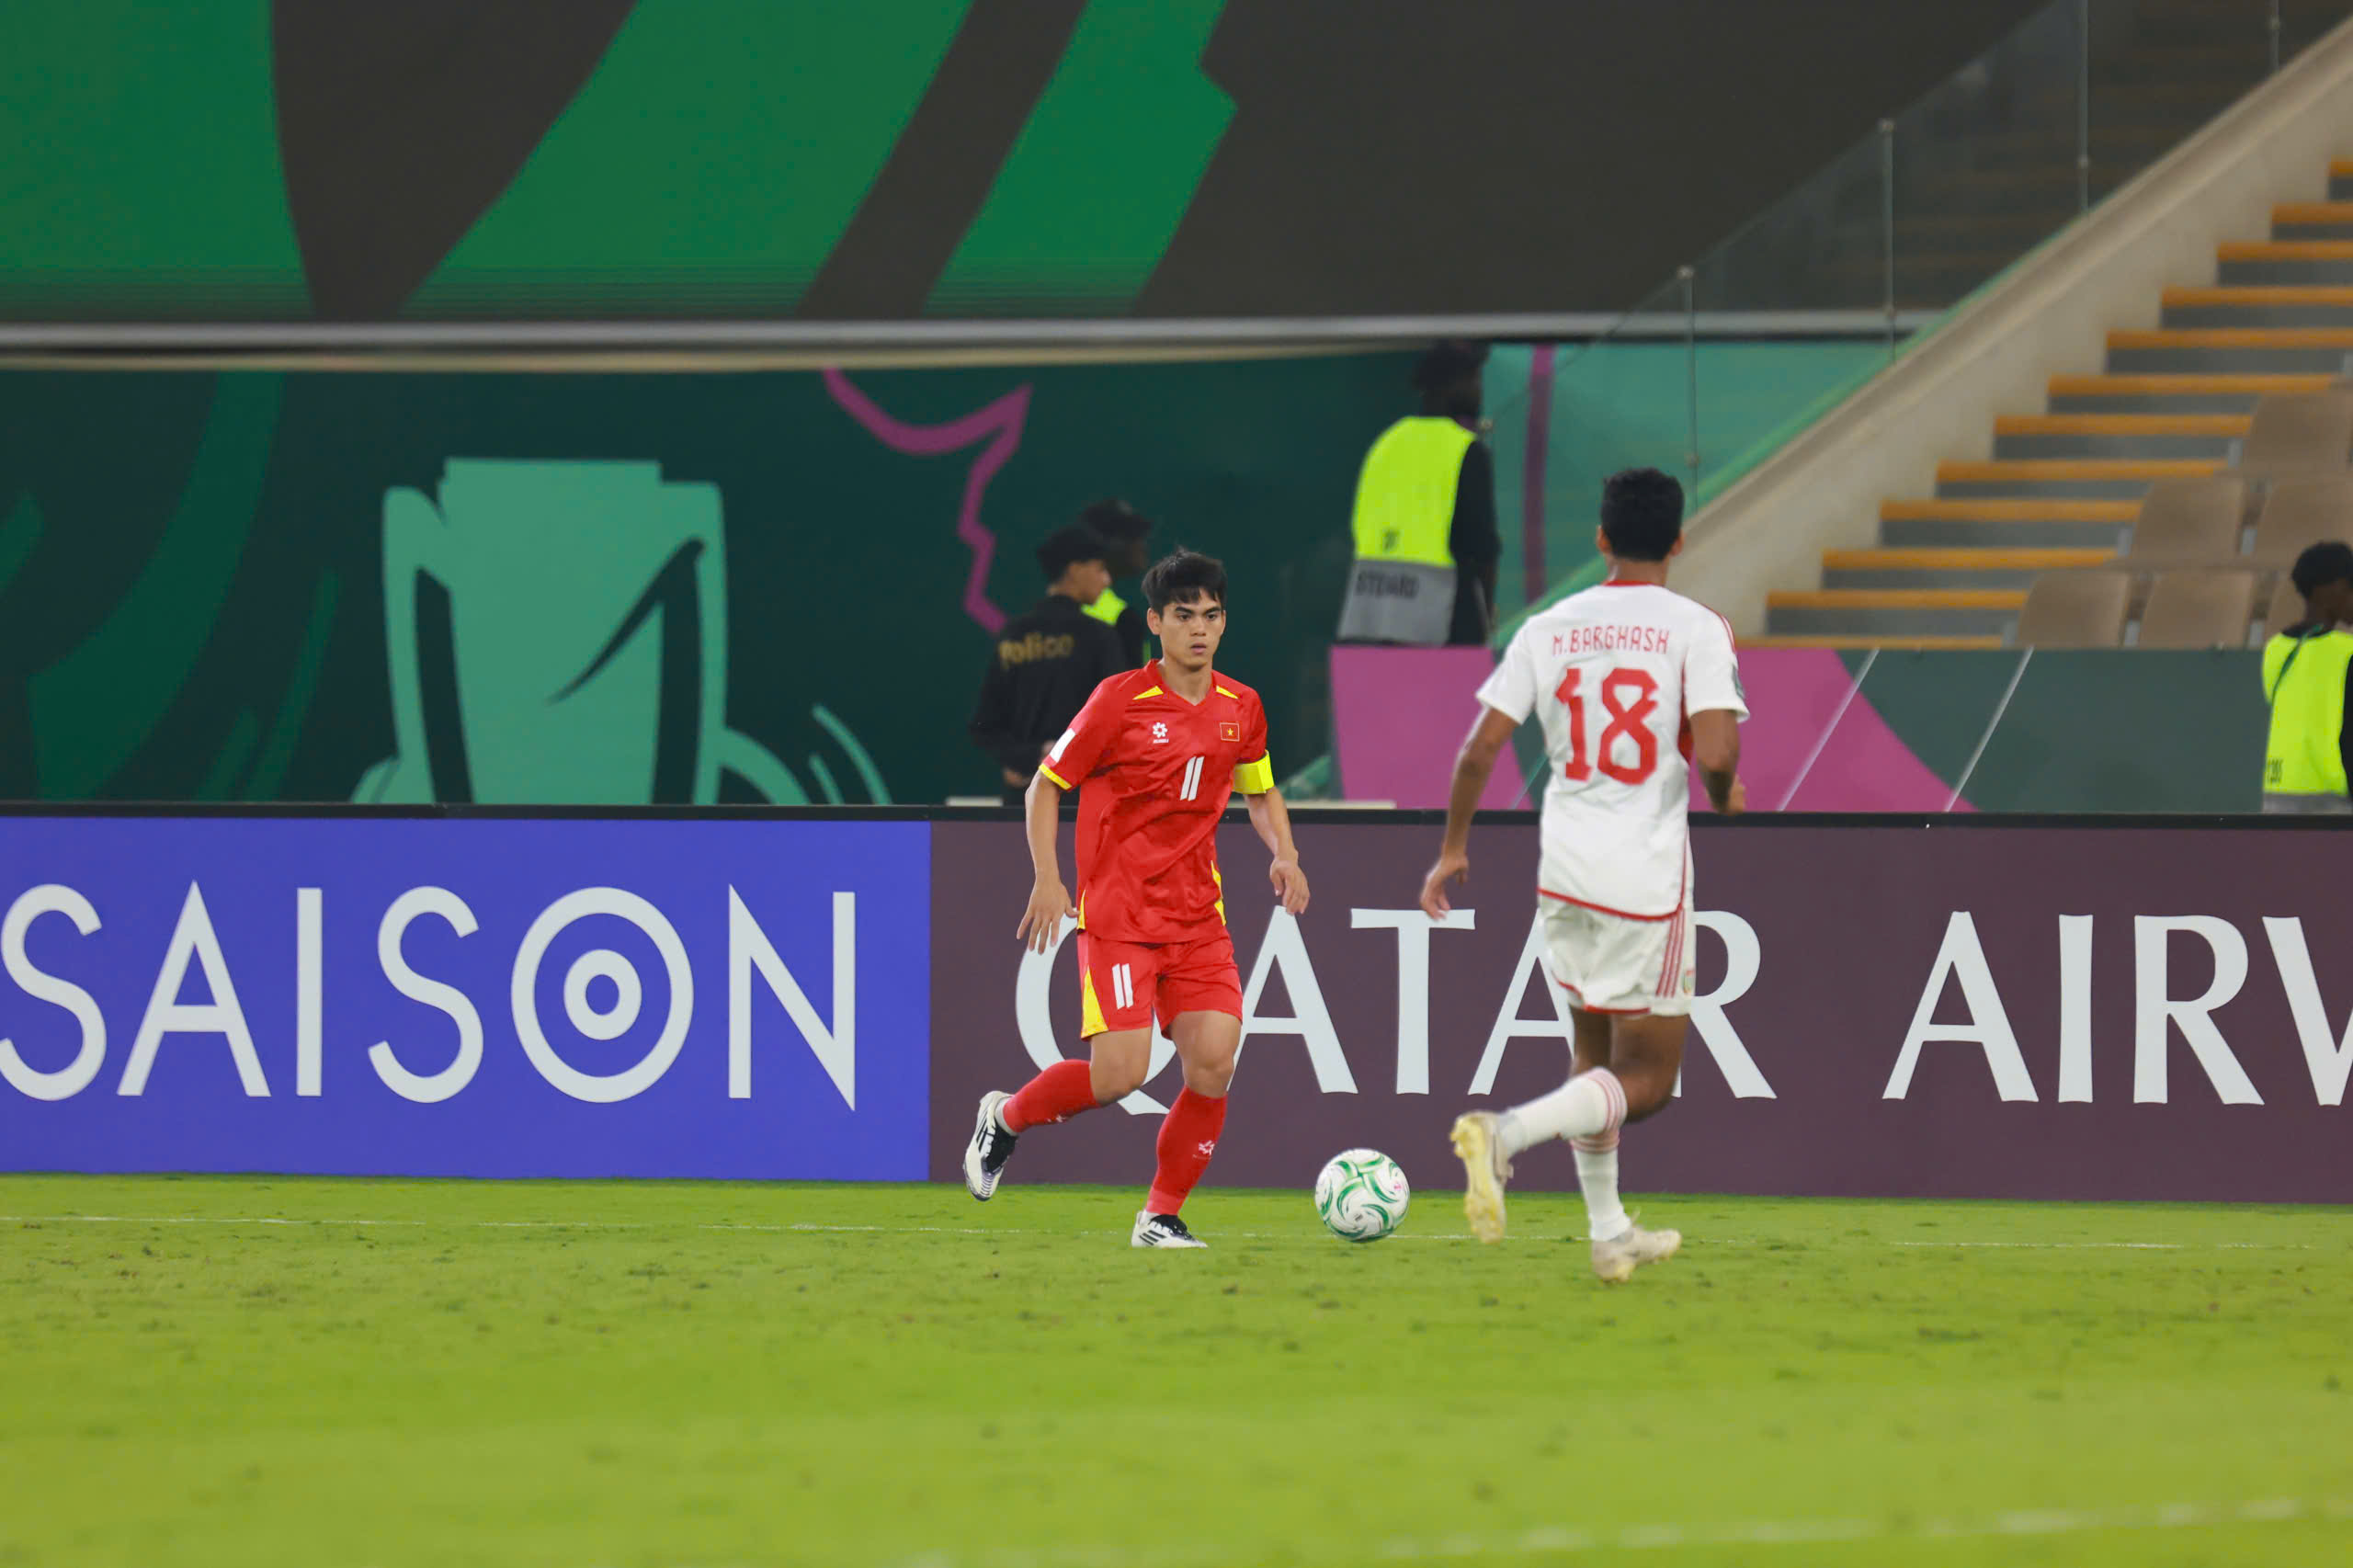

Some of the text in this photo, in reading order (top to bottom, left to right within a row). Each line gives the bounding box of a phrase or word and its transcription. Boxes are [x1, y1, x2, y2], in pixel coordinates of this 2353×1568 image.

[1552, 625, 1669, 656] M.BARGHASH
[1555, 667, 1659, 786] 18
[1180, 756, 1205, 801] 11
[0, 880, 855, 1111] SAISON
[1111, 962, 1134, 1009] 11
